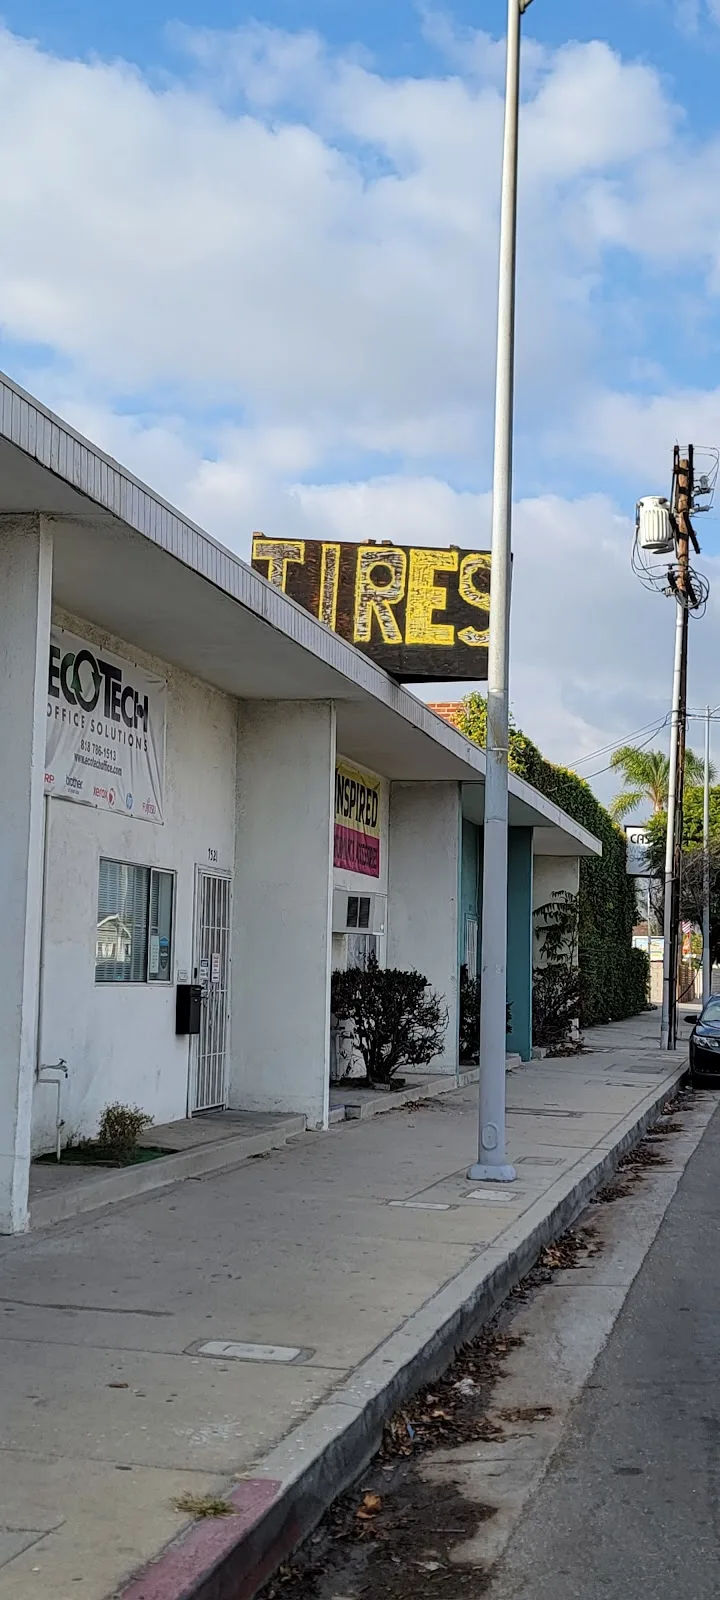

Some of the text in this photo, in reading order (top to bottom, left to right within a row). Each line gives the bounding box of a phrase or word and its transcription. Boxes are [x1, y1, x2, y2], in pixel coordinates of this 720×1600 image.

[253, 538, 491, 647] TIRES
[46, 702, 149, 752] OFFICE SOLUTIONS
[80, 738, 91, 753] 818
[74, 752, 122, 776] www.ecotechoffice.com
